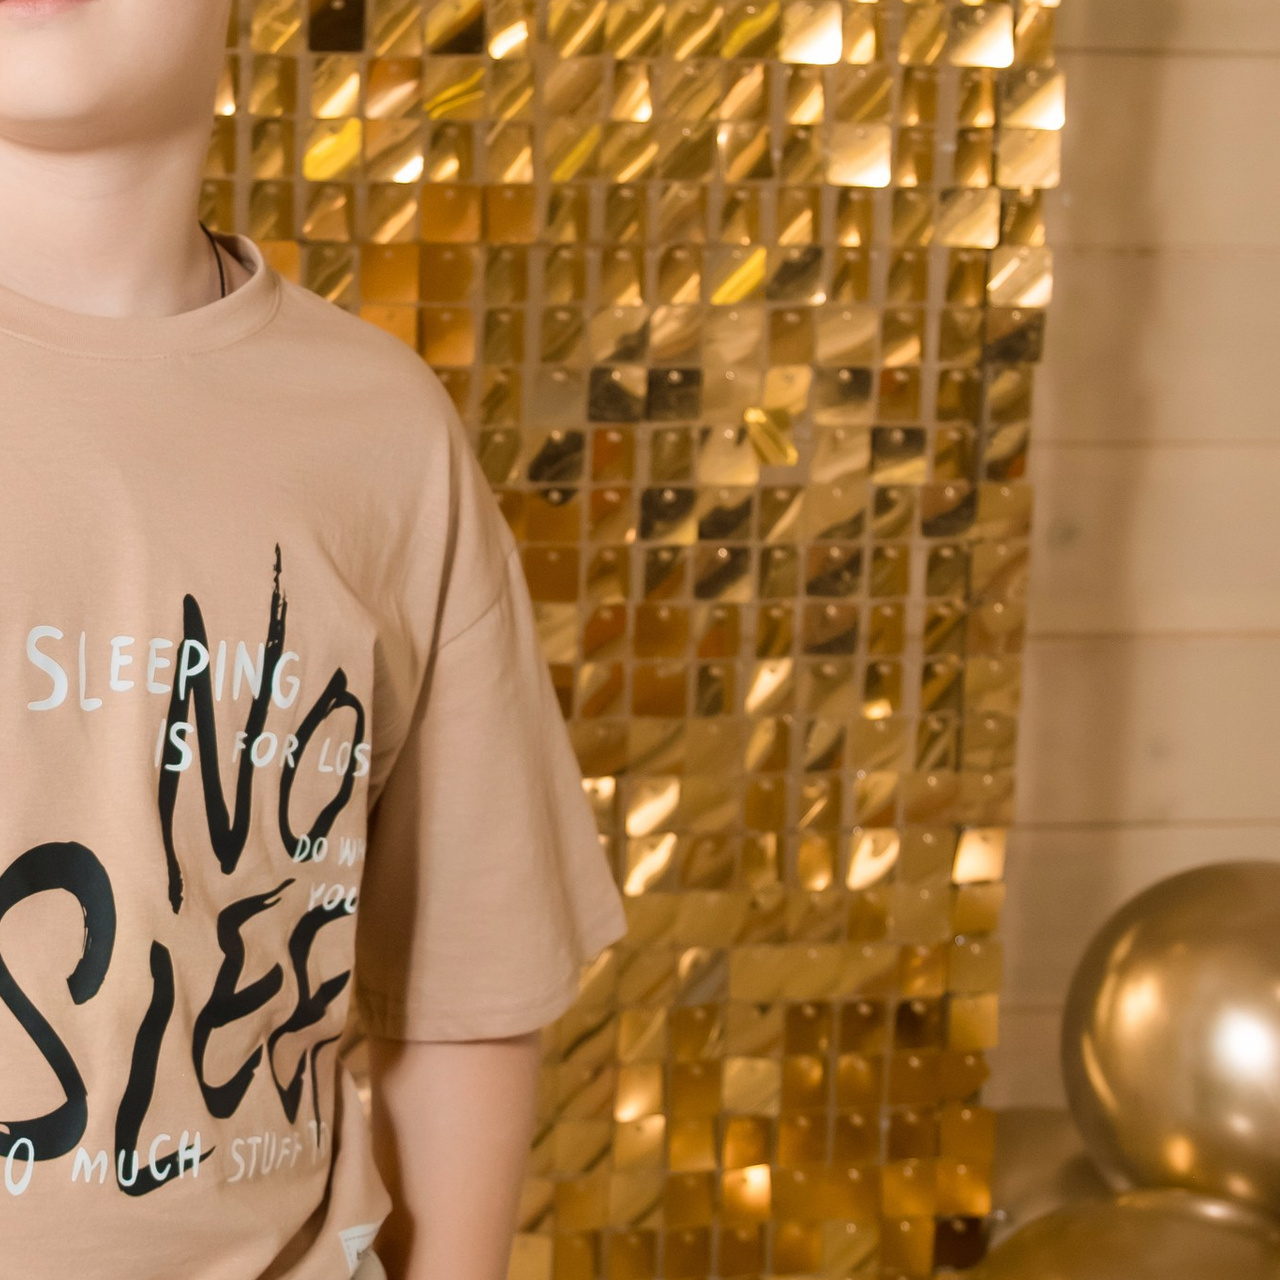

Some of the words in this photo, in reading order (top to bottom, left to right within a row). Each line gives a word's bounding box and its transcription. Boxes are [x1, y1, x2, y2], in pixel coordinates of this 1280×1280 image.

[26, 625, 300, 710] SLEEPING
[155, 718, 194, 771] IS
[232, 730, 299, 768] FOR
[158, 542, 365, 914] NO
[293, 834, 329, 863] DO
[71, 1131, 201, 1186] MUCH
[226, 1131, 302, 1182] STUFF
